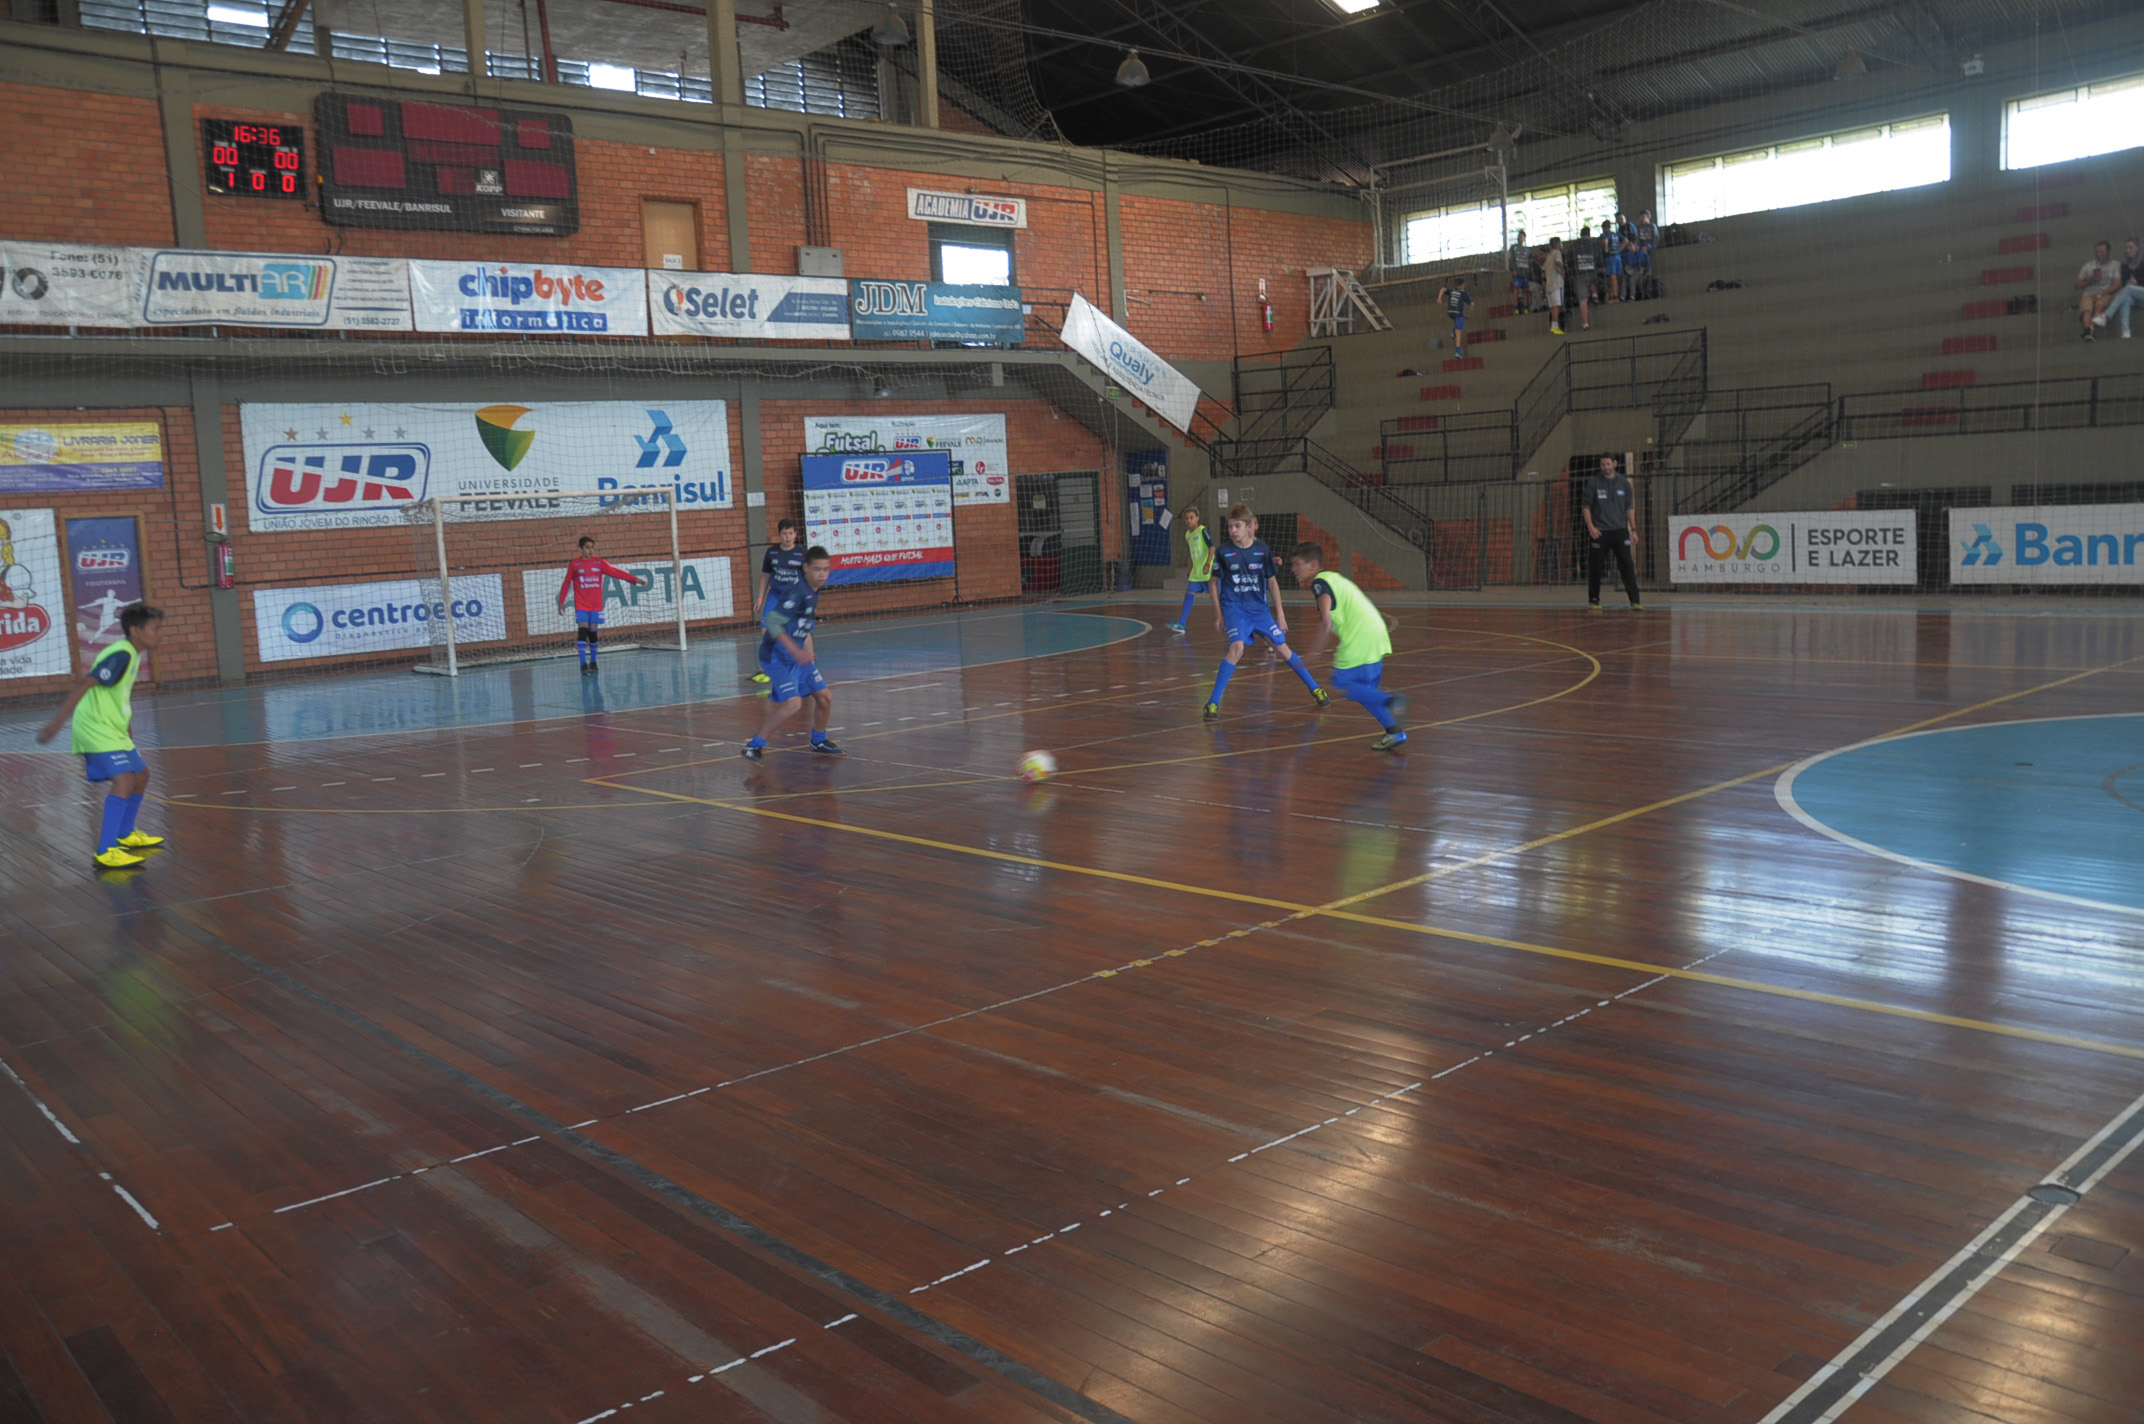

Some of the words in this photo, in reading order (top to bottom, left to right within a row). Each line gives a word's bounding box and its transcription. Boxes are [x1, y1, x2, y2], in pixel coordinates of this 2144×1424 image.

[234, 125, 281, 146] 16:36
[213, 146, 239, 165] 00
[274, 151, 299, 170] 00
[228, 171, 235, 188] 1
[252, 172, 265, 190] 0
[282, 174, 295, 193] 0
[475, 184, 503, 195] KOPP
[333, 198, 452, 214] UJR/FEEVALE/BANRISUL
[501, 208, 546, 220] VISITANTE
[916, 194, 969, 219] ACADEMIA
[973, 201, 1015, 222] UJR
[458, 266, 605, 306] chipbyte
[684, 286, 759, 320] Selet
[855, 281, 928, 316] JDM
[216, 308, 230, 316] em
[1109, 341, 1155, 386] Qualy
[270, 454, 416, 505] UJR
[844, 461, 887, 481] UJR
[458, 477, 560, 490] UNIVERSIDADE
[298, 518, 333, 529] JOVEM
[335, 516, 350, 526] DO
[1807, 528, 1905, 546] ESPORTE
[80, 551, 125, 568] UJR
[1678, 562, 1781, 573] HAMBURGO
[1808, 550, 1820, 567] E
[1829, 550, 1899, 567] LAZER
[331, 599, 483, 629] centroeco
